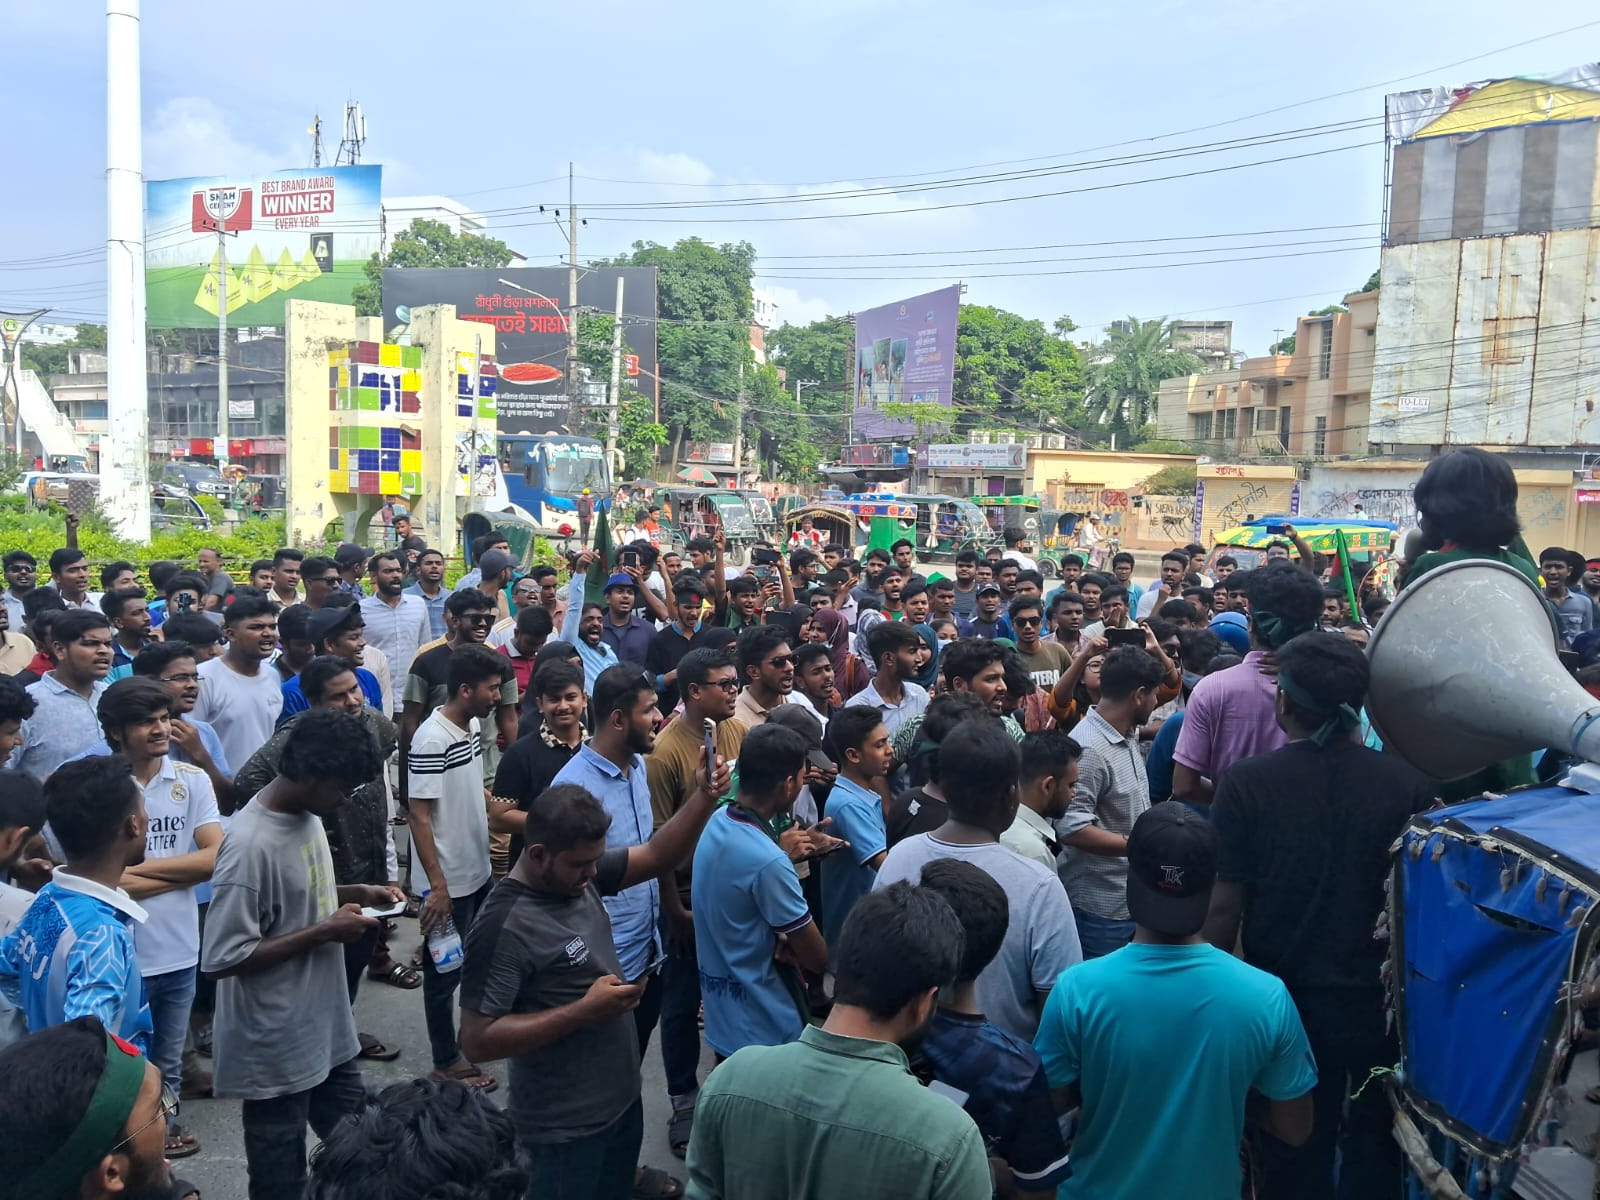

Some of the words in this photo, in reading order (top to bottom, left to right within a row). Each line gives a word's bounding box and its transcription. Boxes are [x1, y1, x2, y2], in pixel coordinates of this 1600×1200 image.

[262, 181, 279, 193] BEST
[281, 178, 307, 192] BRAND
[307, 176, 335, 190] AWARD
[264, 192, 332, 215] WINNER
[275, 216, 299, 230] EVERY
[299, 215, 320, 228] YEAR
[1400, 398, 1429, 406] TO-LET
[149, 814, 186, 833] ates
[146, 834, 177, 851] ETTER
